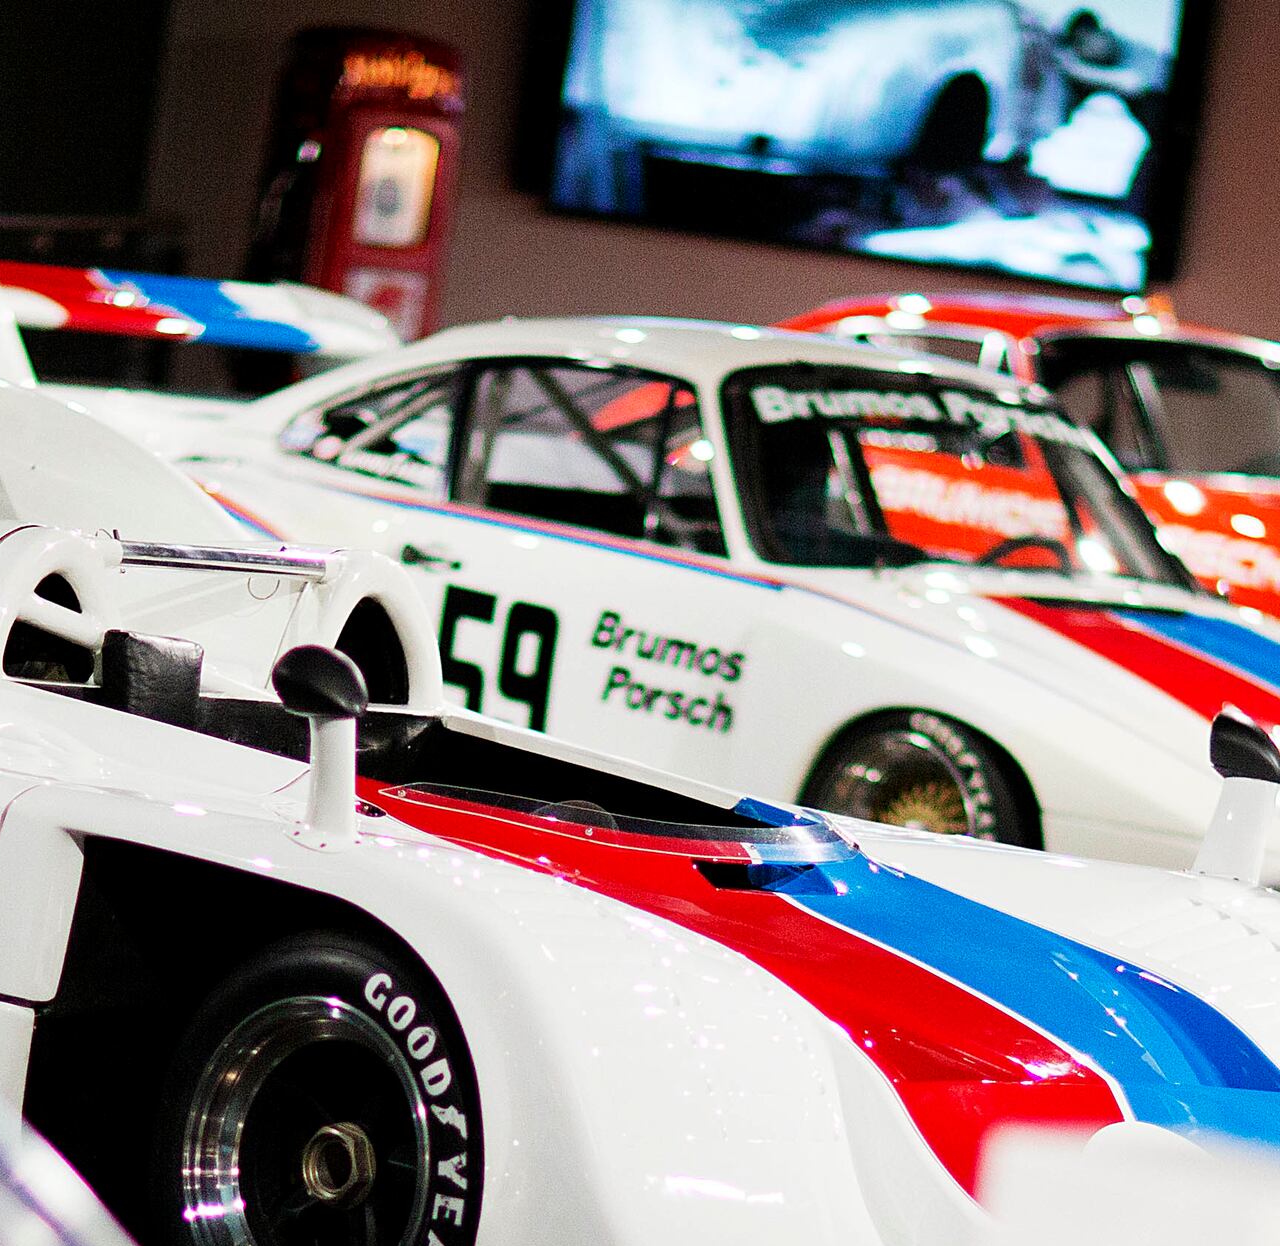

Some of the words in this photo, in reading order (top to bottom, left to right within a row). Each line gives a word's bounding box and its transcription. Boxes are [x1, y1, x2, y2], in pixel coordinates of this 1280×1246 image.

[751, 386, 943, 424] Brumos
[438, 583, 558, 734] 59
[591, 610, 745, 683] Brumos
[602, 666, 734, 733] Porsch
